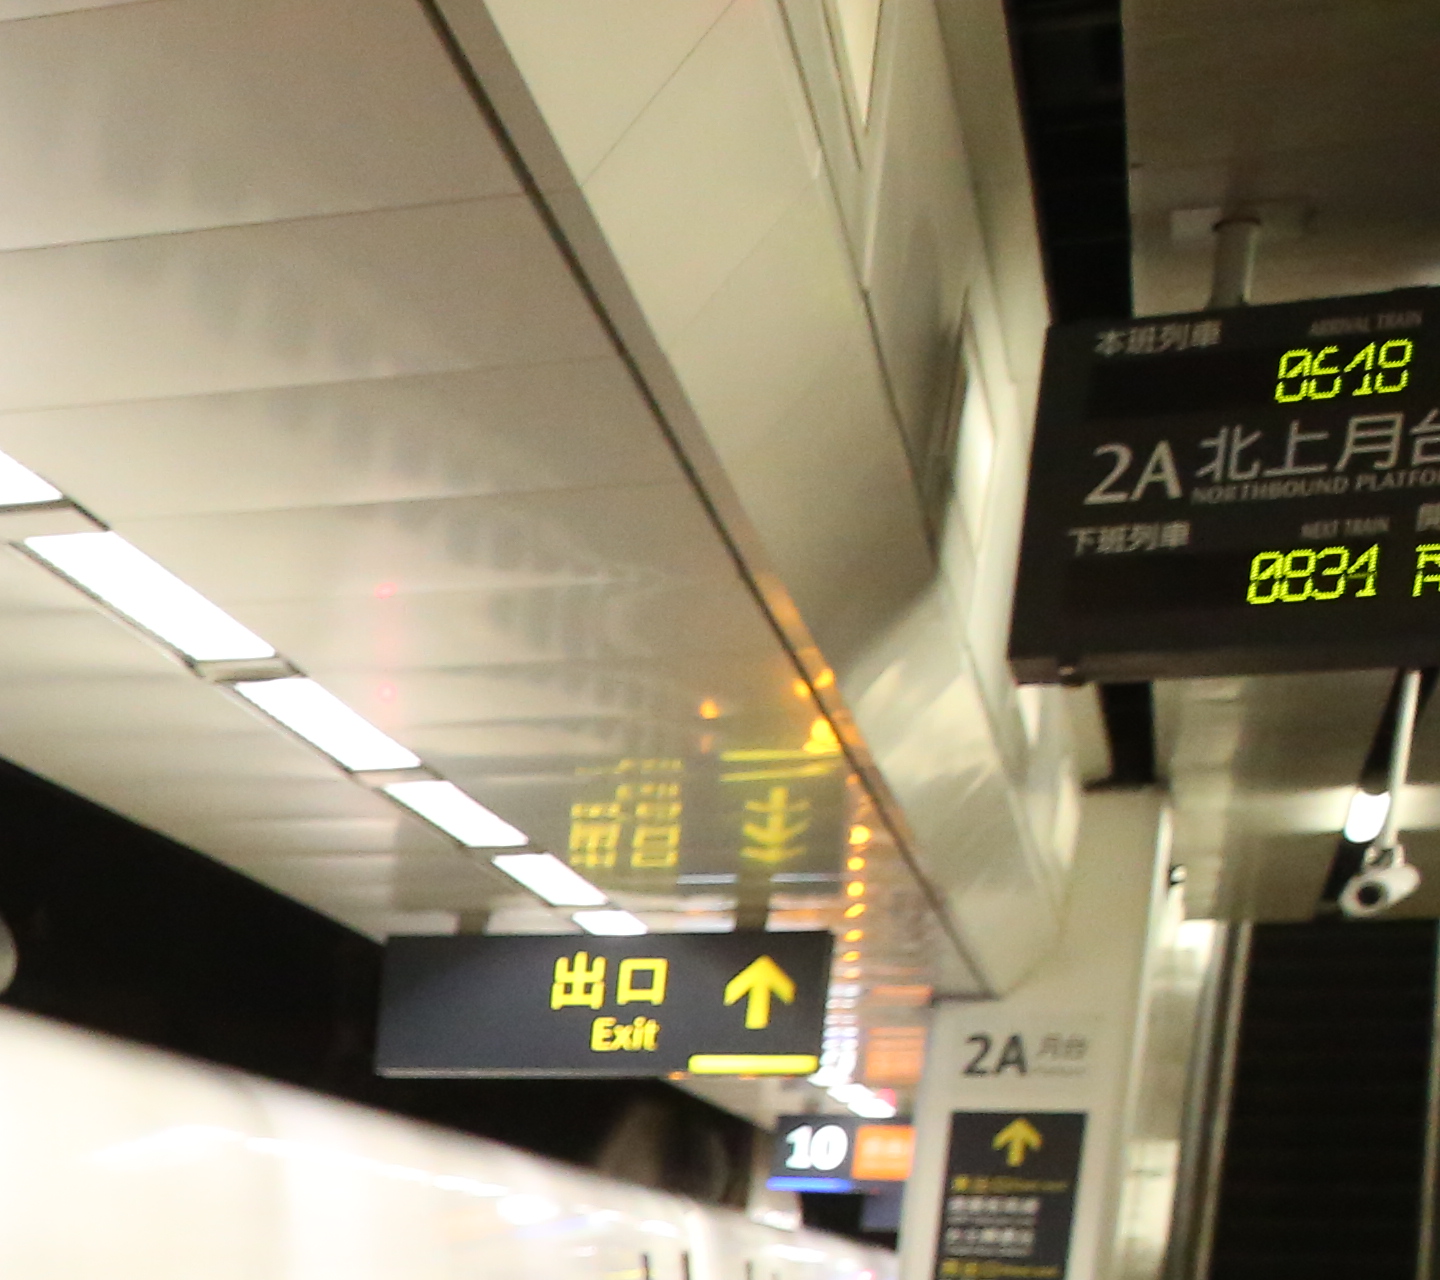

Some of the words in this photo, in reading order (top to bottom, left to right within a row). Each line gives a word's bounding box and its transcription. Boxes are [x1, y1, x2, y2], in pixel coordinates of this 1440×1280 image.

[1083, 441, 1182, 505] 2A
[1192, 475, 1348, 504] NORTHBOUND
[1355, 468, 1440, 492] PLATFO
[551, 951, 668, 1010] 出口
[591, 1016, 662, 1051] Exit
[963, 1033, 1028, 1077] 2A
[785, 1125, 848, 1171] 10
